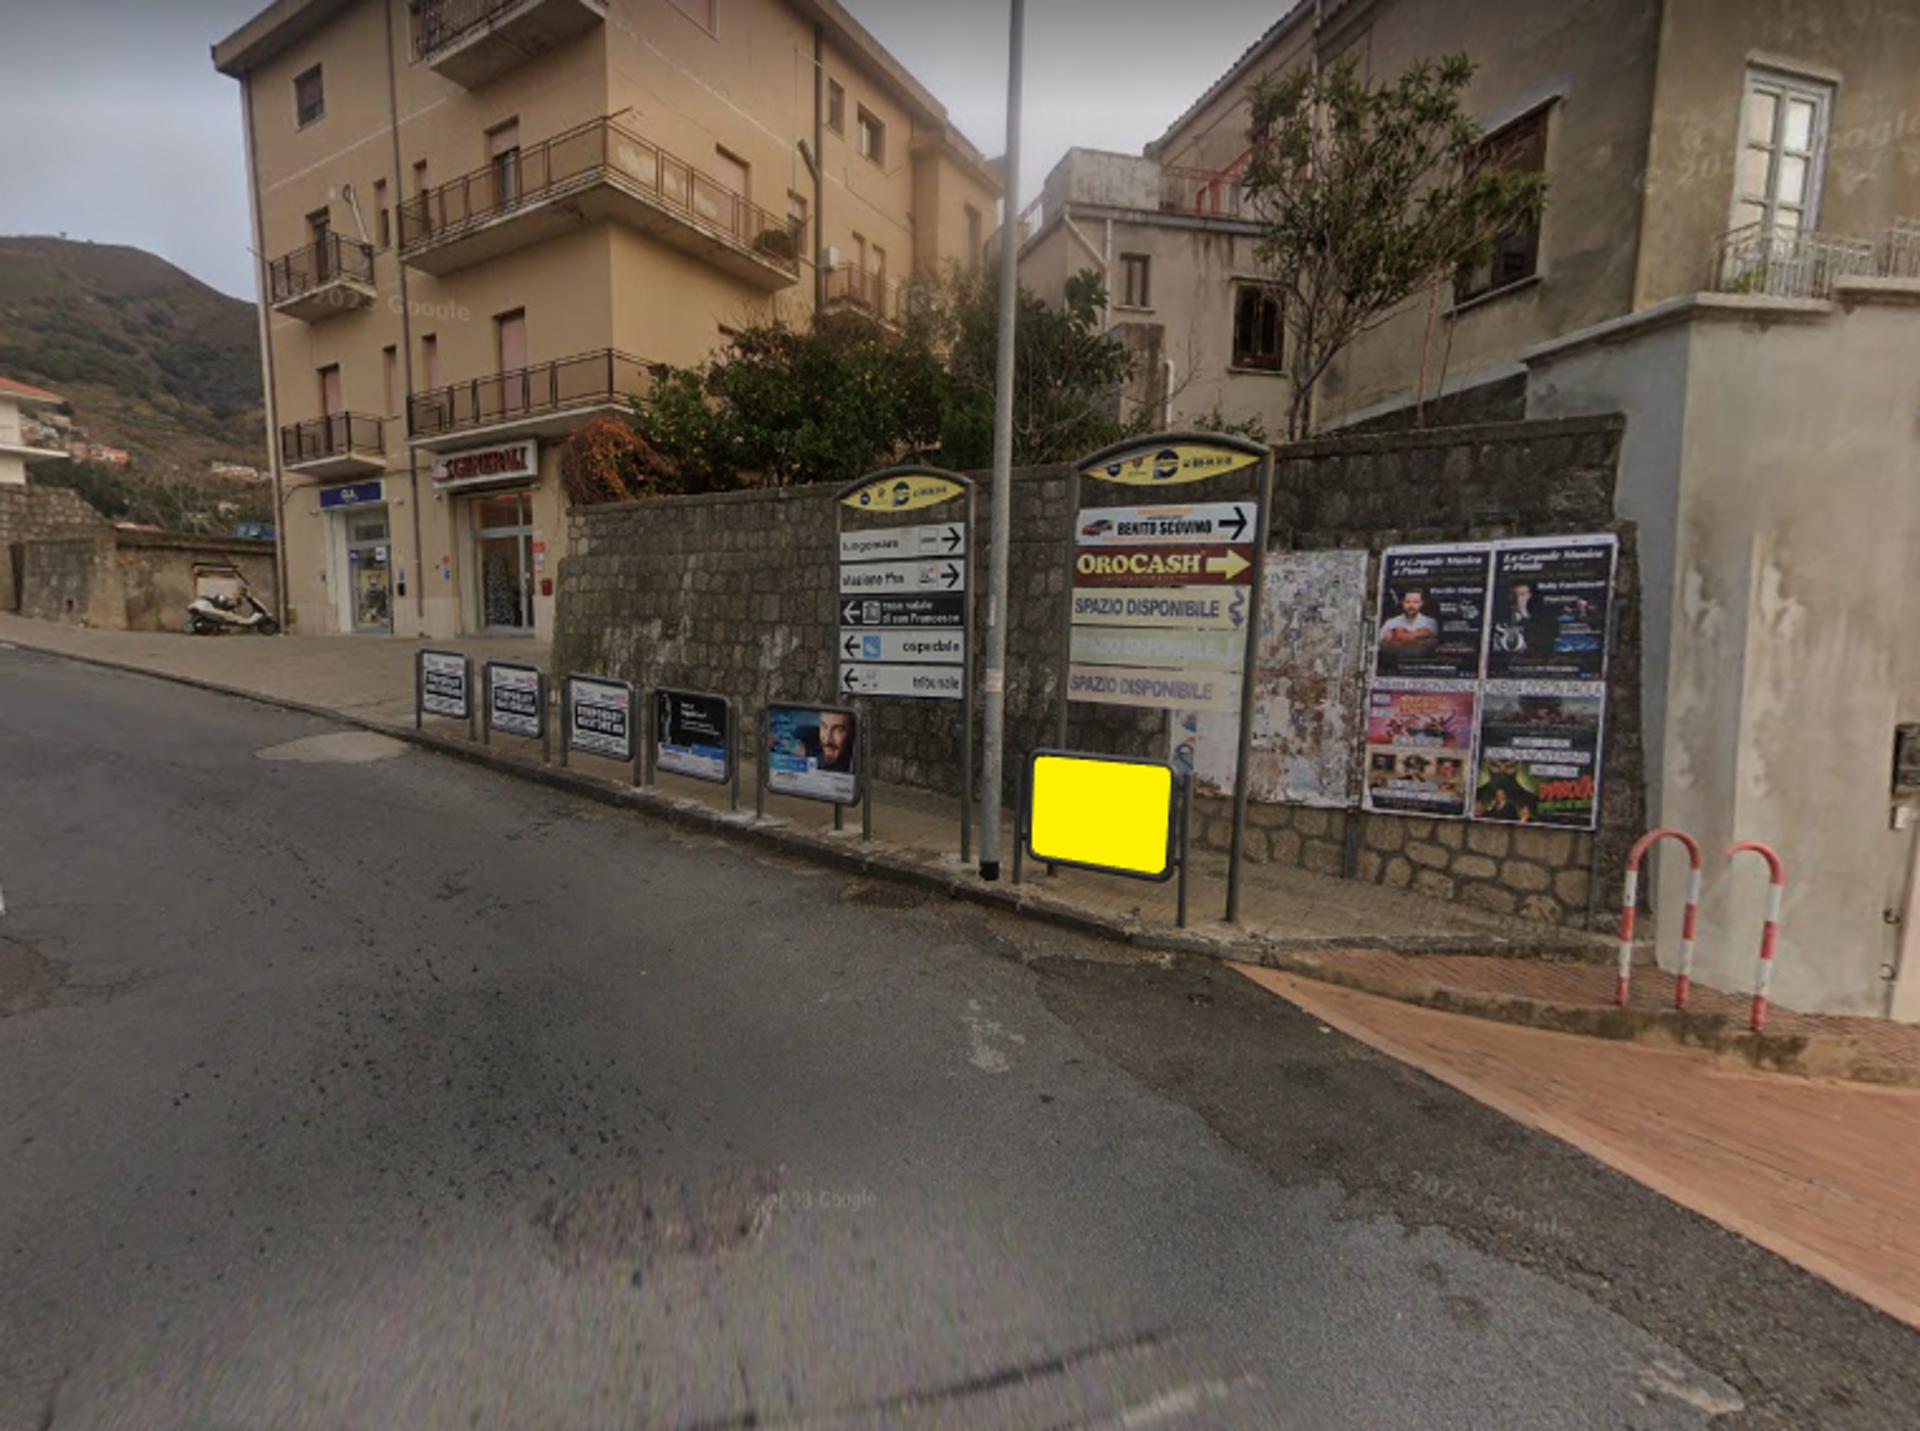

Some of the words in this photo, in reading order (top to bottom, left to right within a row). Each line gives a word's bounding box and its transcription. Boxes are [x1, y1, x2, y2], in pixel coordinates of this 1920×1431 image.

[1075, 598, 1124, 615] SPAZIO
[1127, 599, 1220, 619] DISPONIBILE
[1070, 675, 1118, 693] SPAZIO
[1120, 677, 1213, 701] DISPONIBILE
